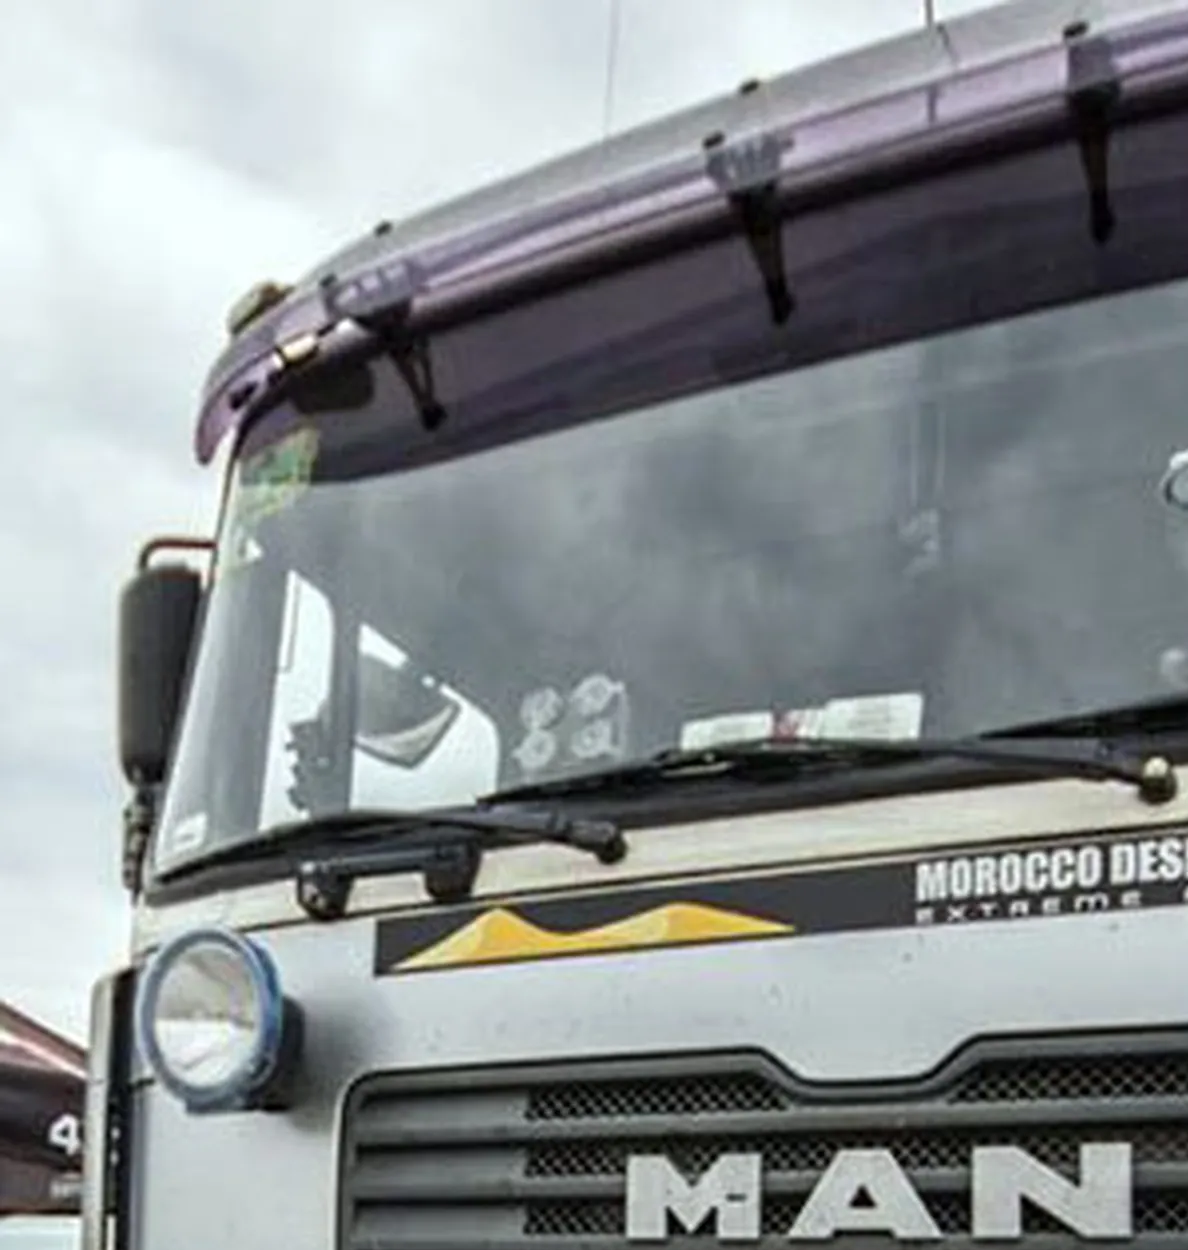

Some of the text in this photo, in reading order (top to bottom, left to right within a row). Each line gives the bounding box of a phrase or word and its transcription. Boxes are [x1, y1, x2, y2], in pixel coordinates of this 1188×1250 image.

[915, 846, 1101, 901] MOROCCO
[915, 890, 1142, 925] EXTREME
[626, 1142, 1133, 1240] MAN
